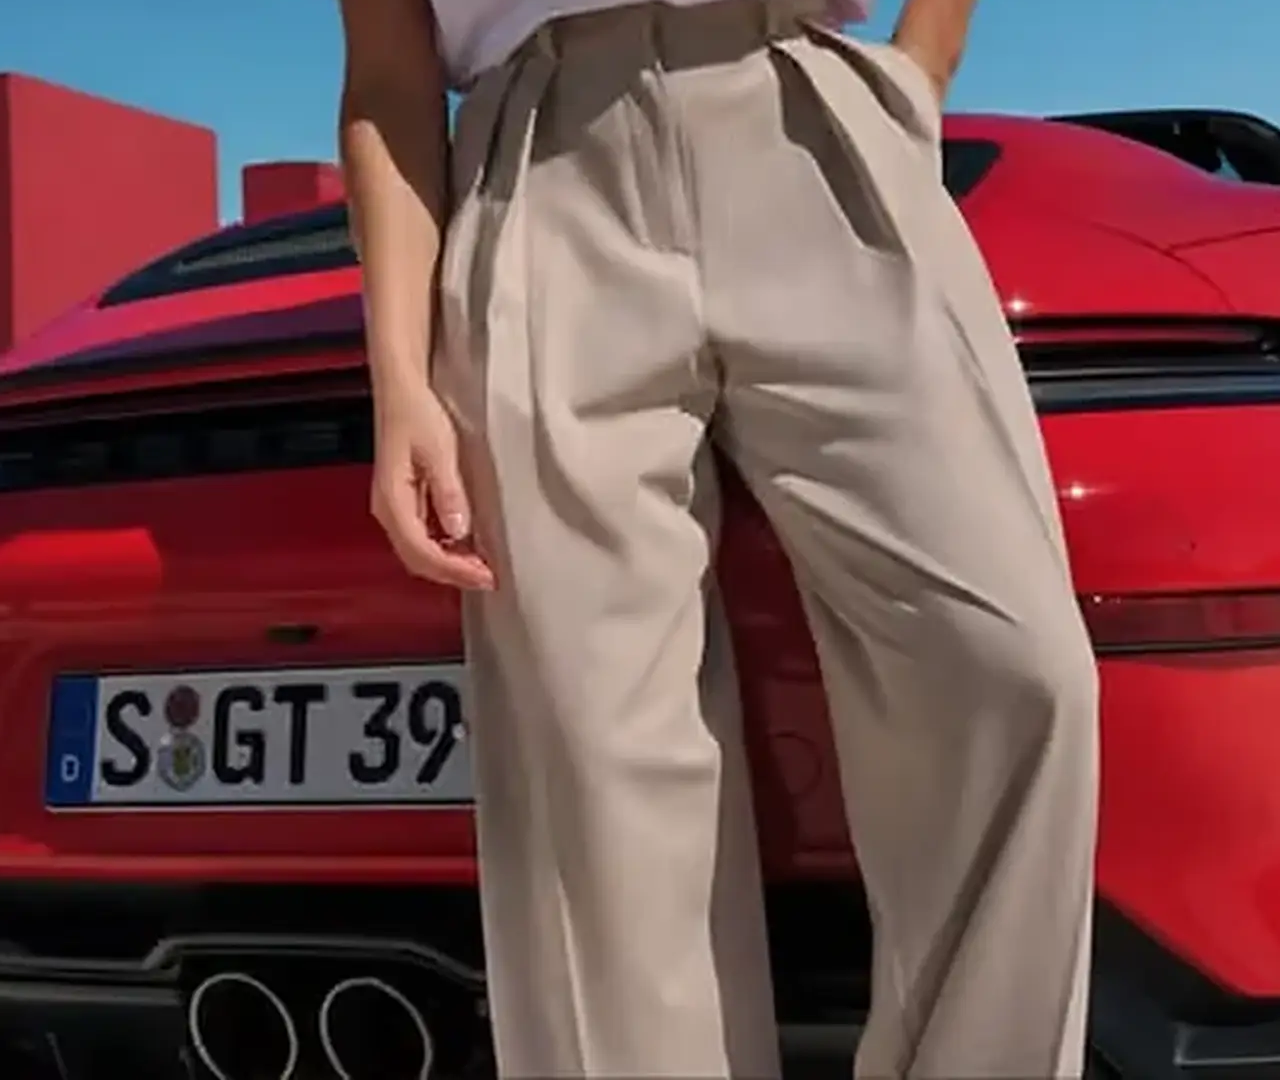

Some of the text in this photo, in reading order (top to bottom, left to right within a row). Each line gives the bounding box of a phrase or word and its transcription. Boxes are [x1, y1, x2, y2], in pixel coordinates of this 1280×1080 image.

[61, 753, 80, 783] D
[101, 690, 152, 787] S
[212, 685, 326, 786] GT
